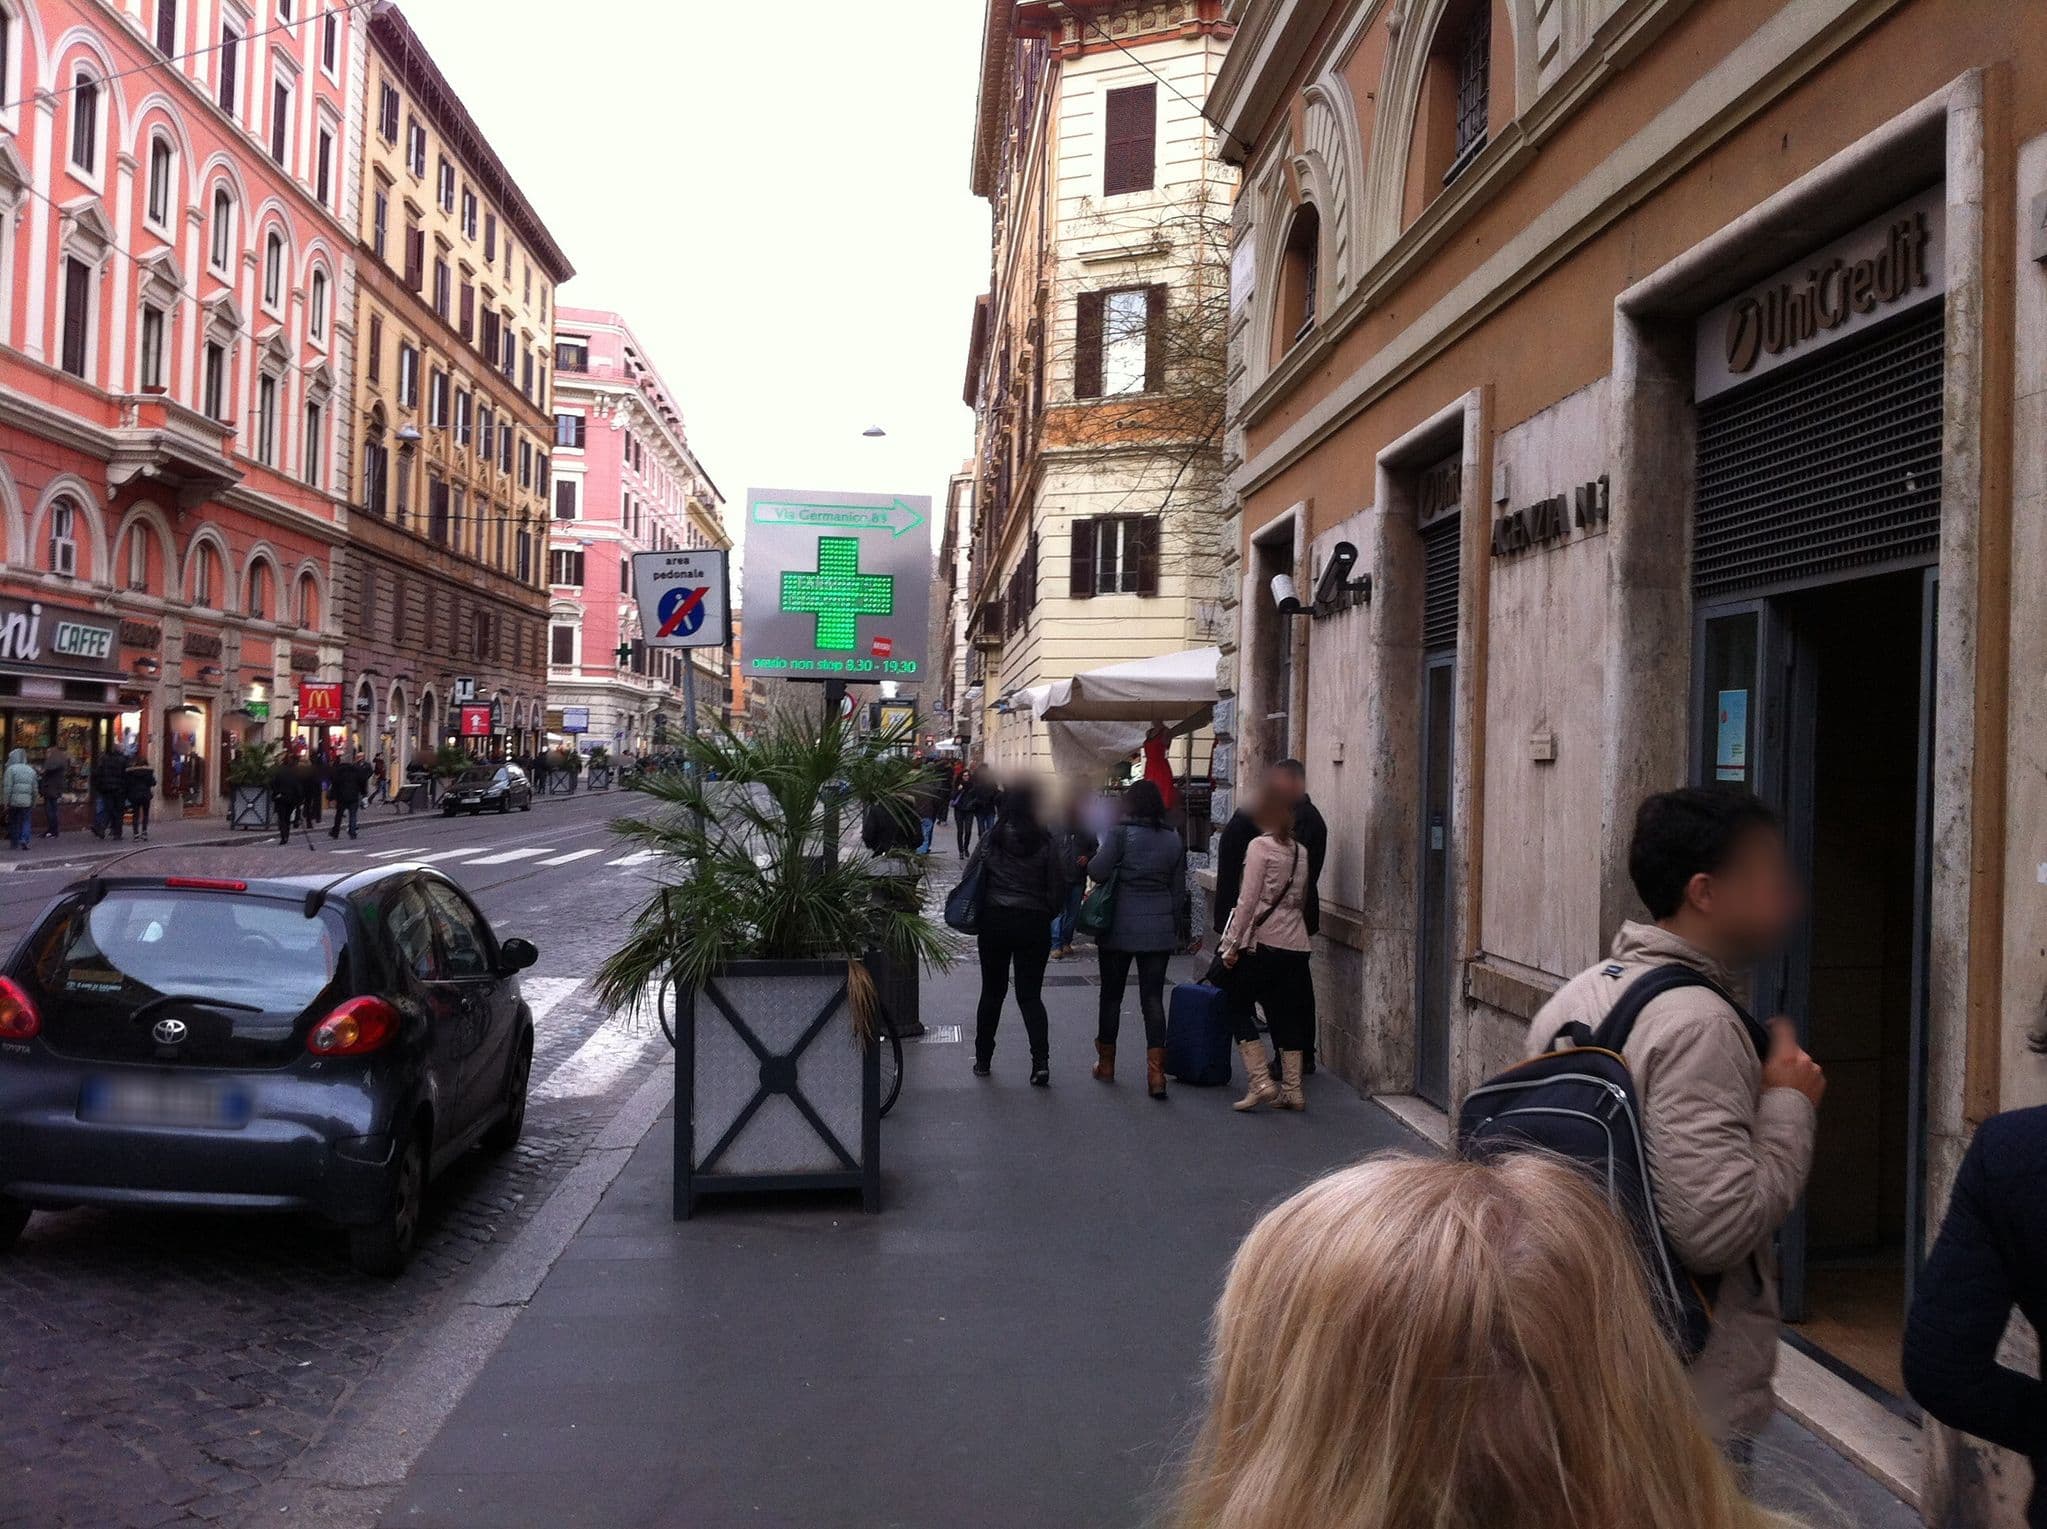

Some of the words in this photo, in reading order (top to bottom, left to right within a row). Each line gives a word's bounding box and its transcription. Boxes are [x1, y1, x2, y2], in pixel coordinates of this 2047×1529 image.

[1761, 211, 1931, 354] UniCredit
[774, 508, 795, 520] Via
[653, 569, 704, 581] pedonale
[0, 604, 42, 660] ni
[790, 660, 814, 670] non
[817, 659, 843, 672] stop
